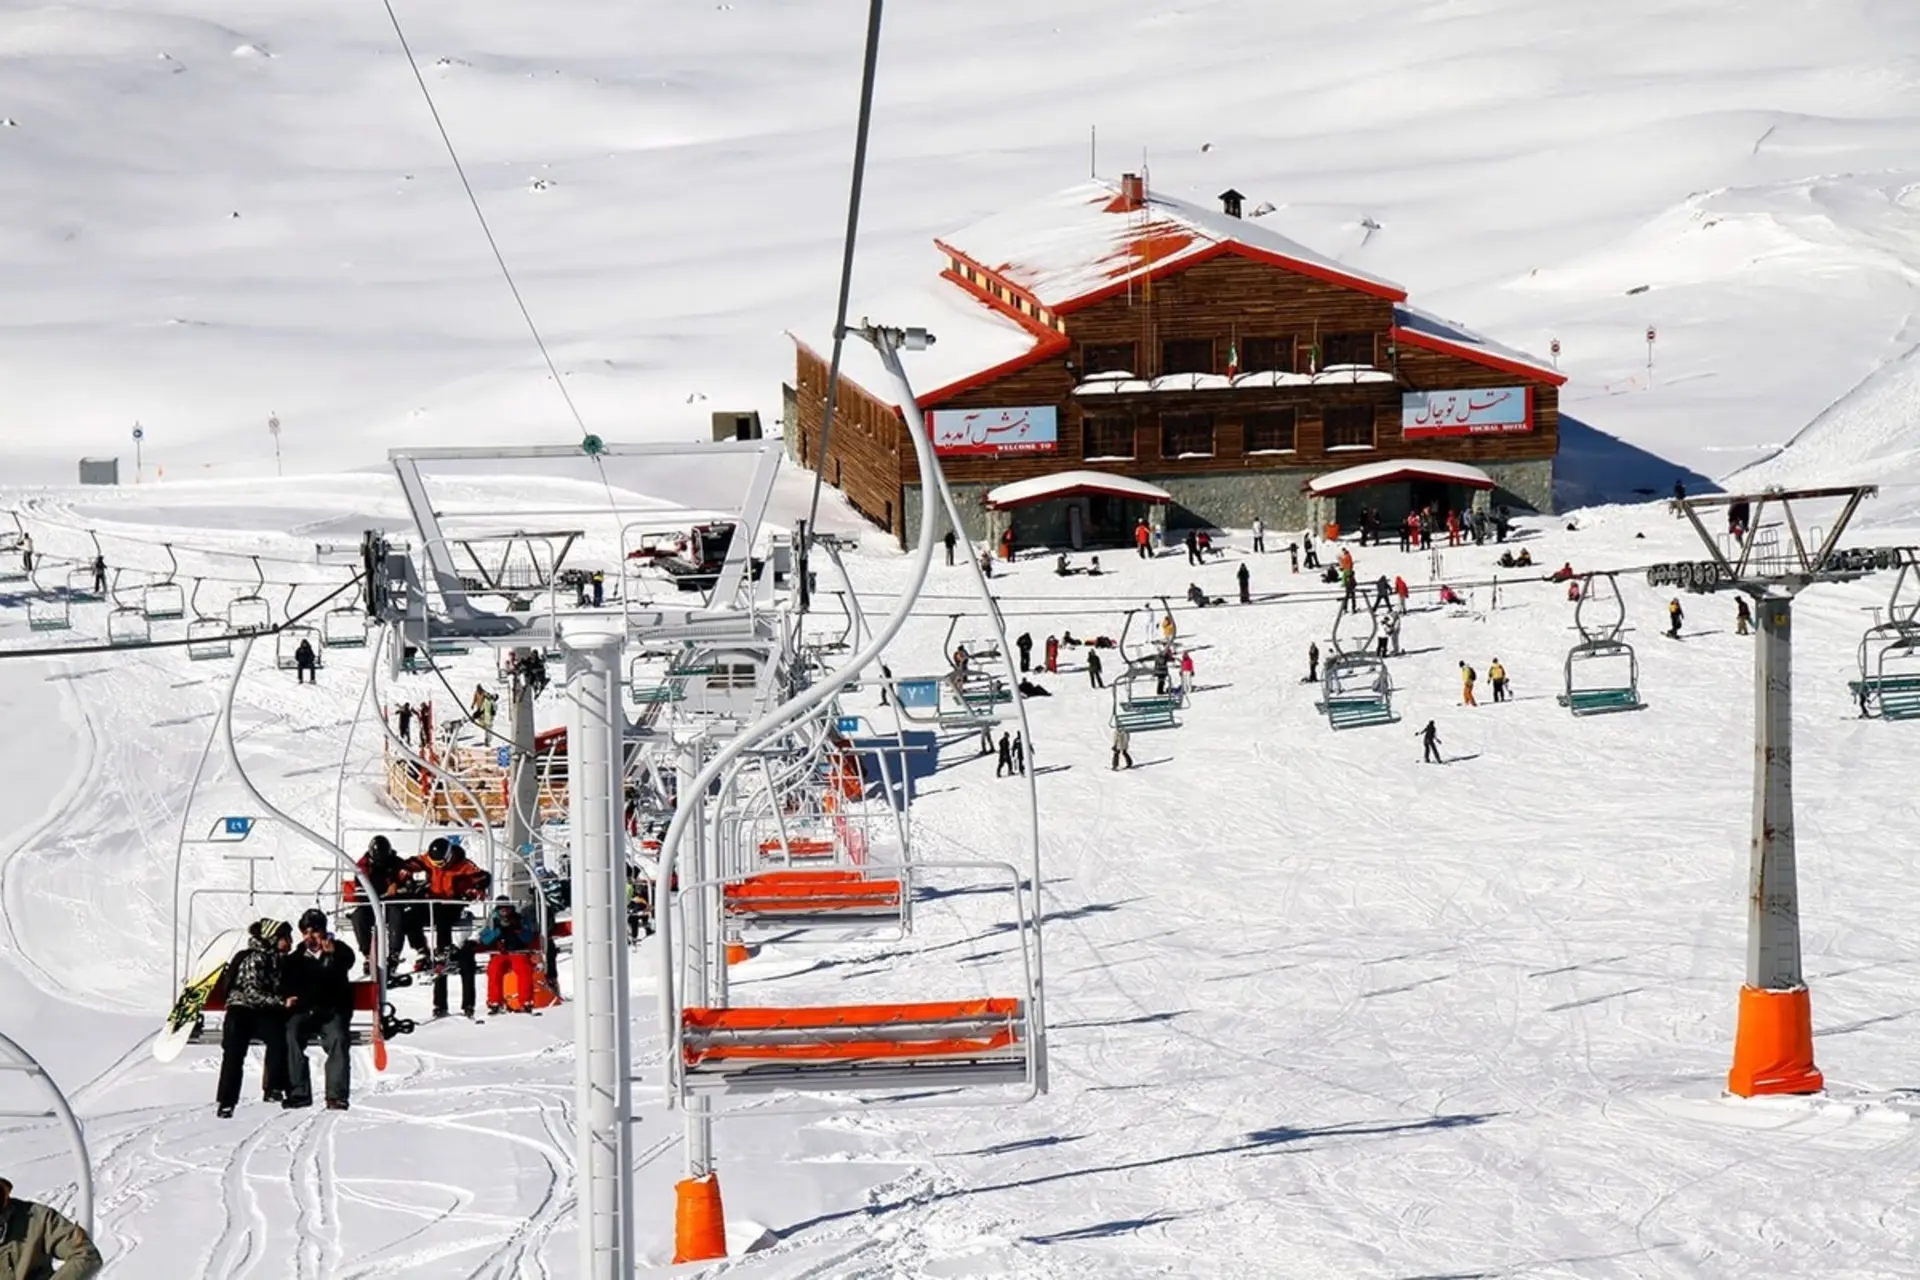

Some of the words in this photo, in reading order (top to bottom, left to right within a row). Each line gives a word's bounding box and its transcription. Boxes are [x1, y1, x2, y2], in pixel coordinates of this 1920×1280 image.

[940, 412, 981, 448] آمدید
[971, 410, 1031, 446] خوش
[1415, 396, 1456, 430] توچال
[997, 444, 1036, 452] WELCOME
[1039, 442, 1052, 450] TO
